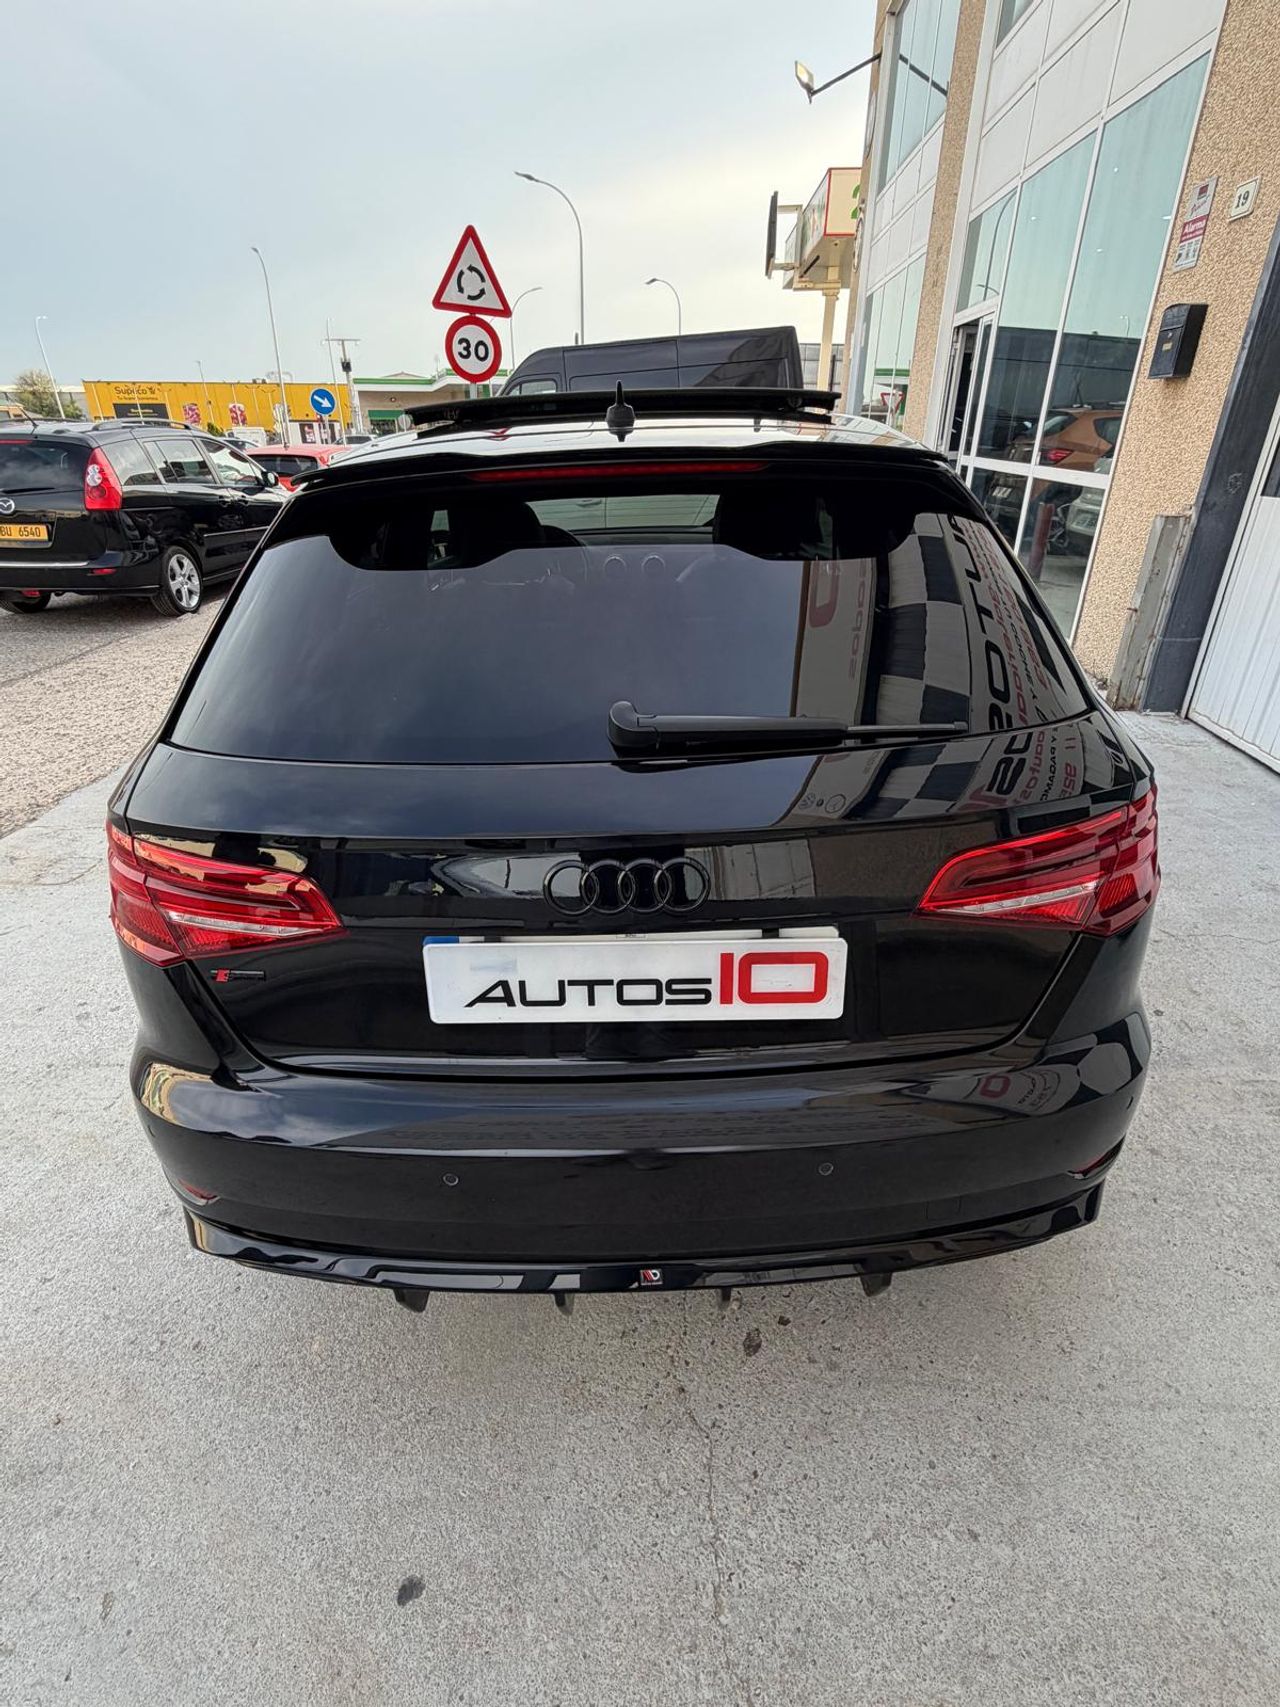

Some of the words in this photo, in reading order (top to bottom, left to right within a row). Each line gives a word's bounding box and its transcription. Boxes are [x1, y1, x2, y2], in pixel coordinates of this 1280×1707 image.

[1234, 191, 1250, 210] 19
[457, 337, 489, 362] 30
[18, 527, 41, 537] 6540
